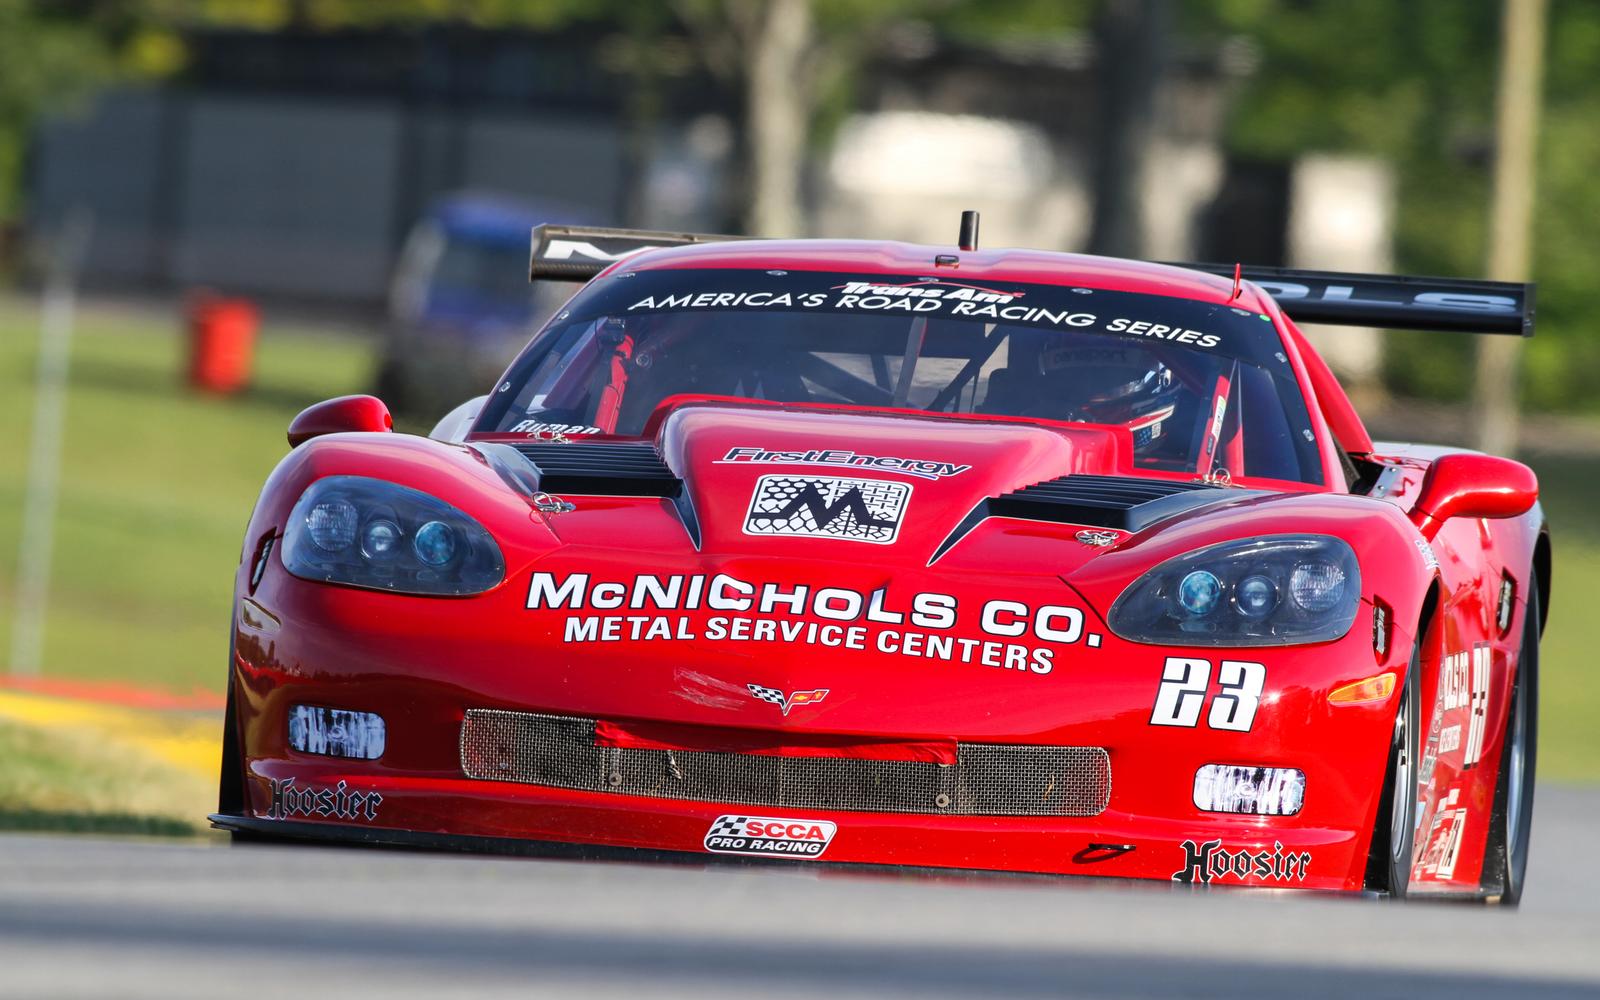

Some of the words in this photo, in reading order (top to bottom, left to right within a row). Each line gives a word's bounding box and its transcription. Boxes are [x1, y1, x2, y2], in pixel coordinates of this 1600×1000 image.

[842, 281, 945, 297] Trans
[942, 287, 1014, 304] Am
[628, 291, 827, 312] AMERICA'S
[835, 295, 942, 312] ROAD
[951, 301, 1098, 328] RACING
[1105, 318, 1222, 347] SERIES
[509, 419, 601, 434] Ruman
[722, 447, 972, 476] FirstEnergy
[525, 571, 958, 629] McNICHOLS
[980, 599, 1104, 648] CO.
[563, 615, 695, 643] METAL
[704, 616, 867, 651] SERVICE
[876, 630, 1054, 675] CENTERS
[1148, 656, 1267, 733] 23
[265, 776, 383, 821] Hoosier
[708, 837, 746, 848] PRO
[749, 840, 821, 853] RACING
[745, 821, 826, 840] SCCA
[1171, 838, 1312, 883] Hoosier
